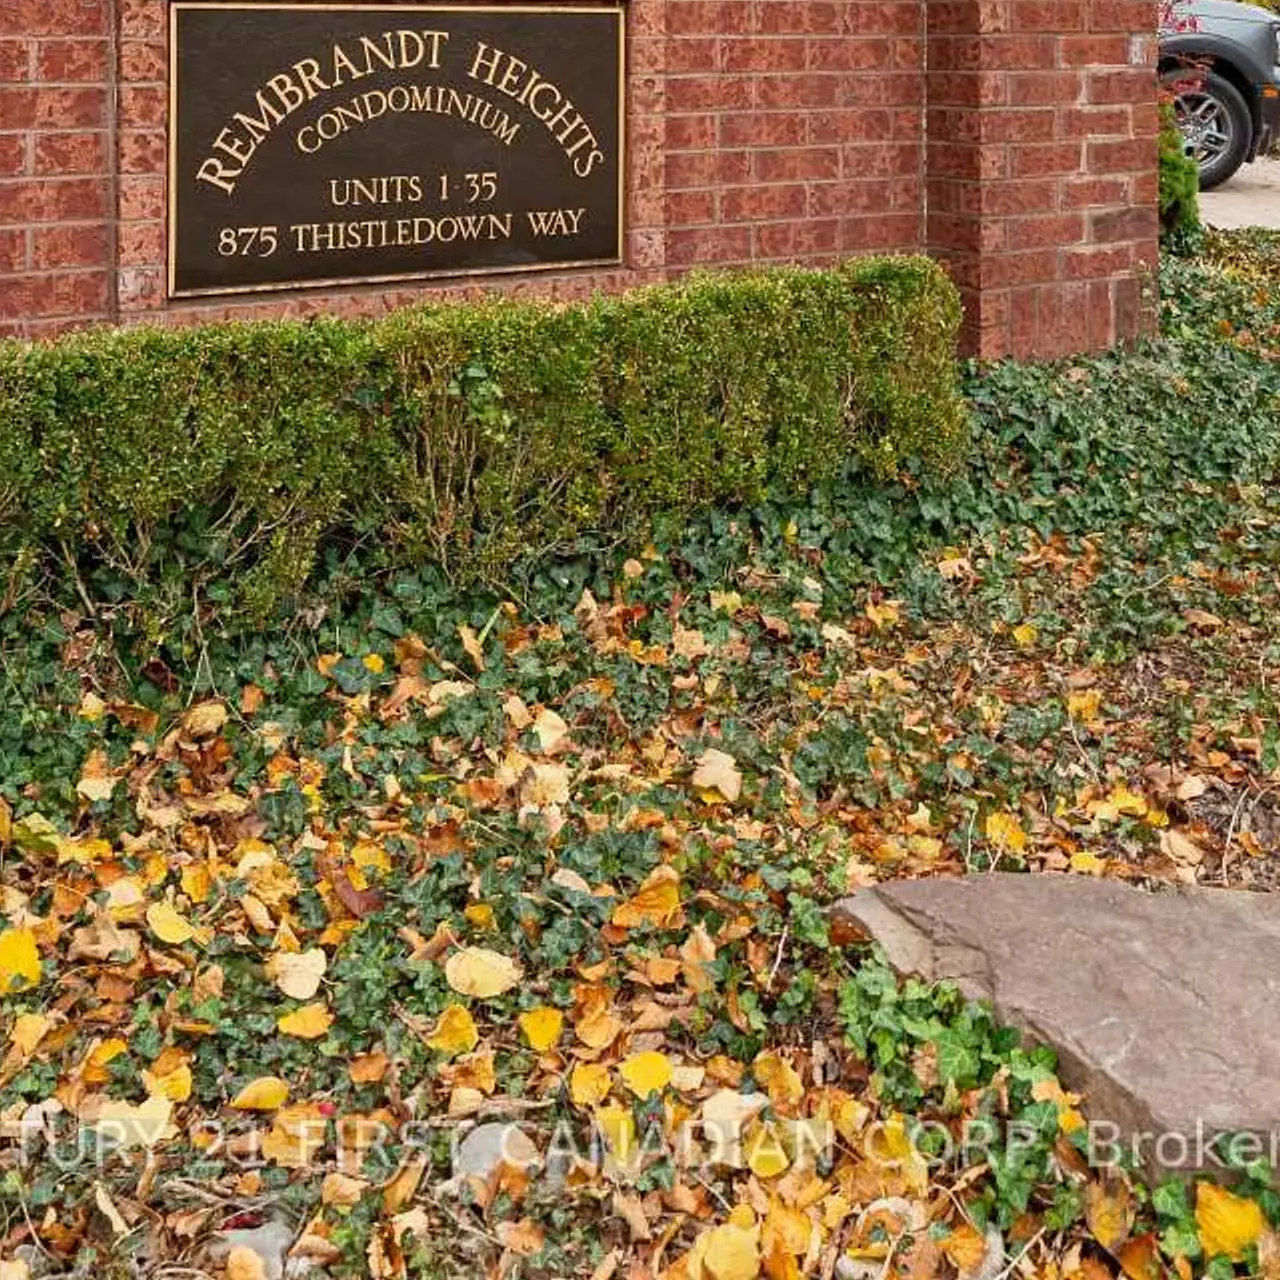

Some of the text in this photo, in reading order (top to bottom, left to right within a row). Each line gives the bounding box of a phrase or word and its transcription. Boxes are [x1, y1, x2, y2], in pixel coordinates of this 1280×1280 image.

[196, 30, 605, 196] REMBRANDT HEIGHTS
[297, 85, 520, 154] CONDOMINIUM
[329, 175, 422, 206] UNITS
[218, 208, 586, 257] 875 THISTLEDOWN WAY
